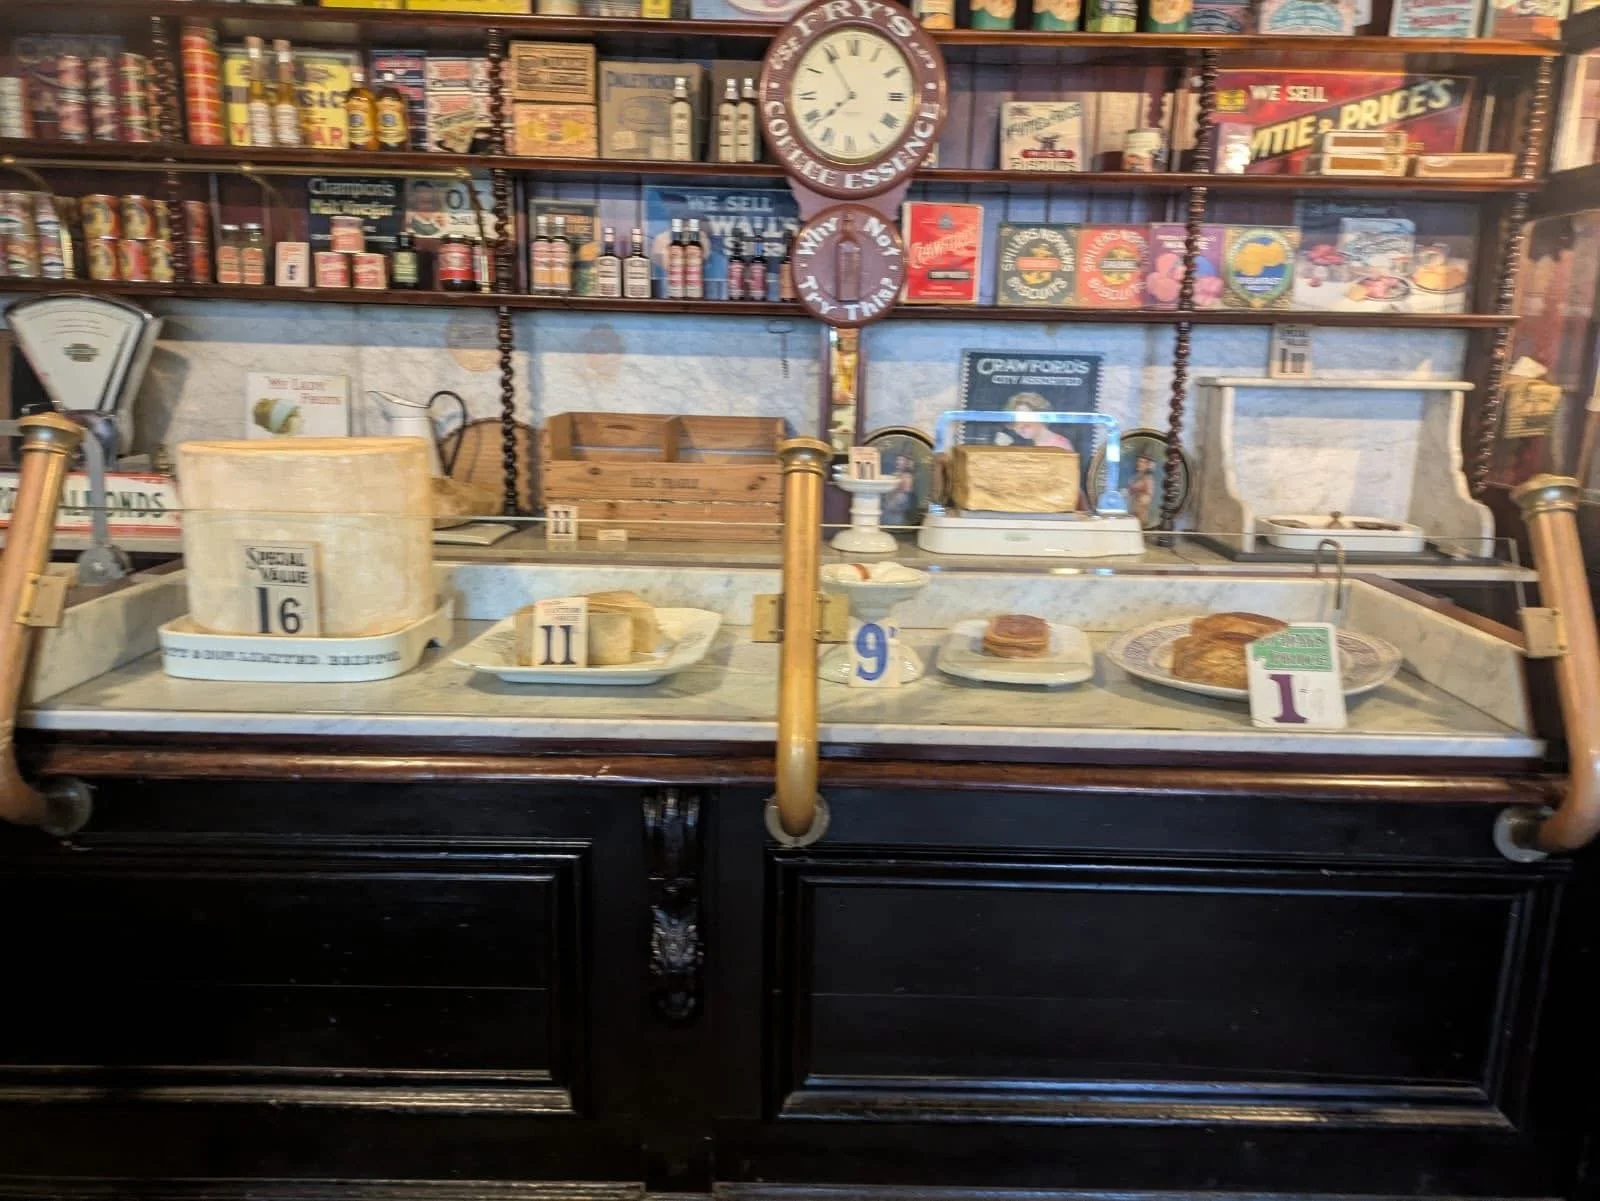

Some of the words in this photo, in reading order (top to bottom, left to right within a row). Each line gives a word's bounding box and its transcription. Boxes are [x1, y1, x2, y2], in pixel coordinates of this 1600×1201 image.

[793, 0, 916, 37] FRY'S
[1249, 85, 1280, 101] WE
[1286, 86, 1328, 103] SELL
[764, 100, 837, 187] COFFEE
[844, 102, 940, 189] ESSENCE
[727, 195, 774, 213] SELL
[258, 568, 309, 584] VALUE
